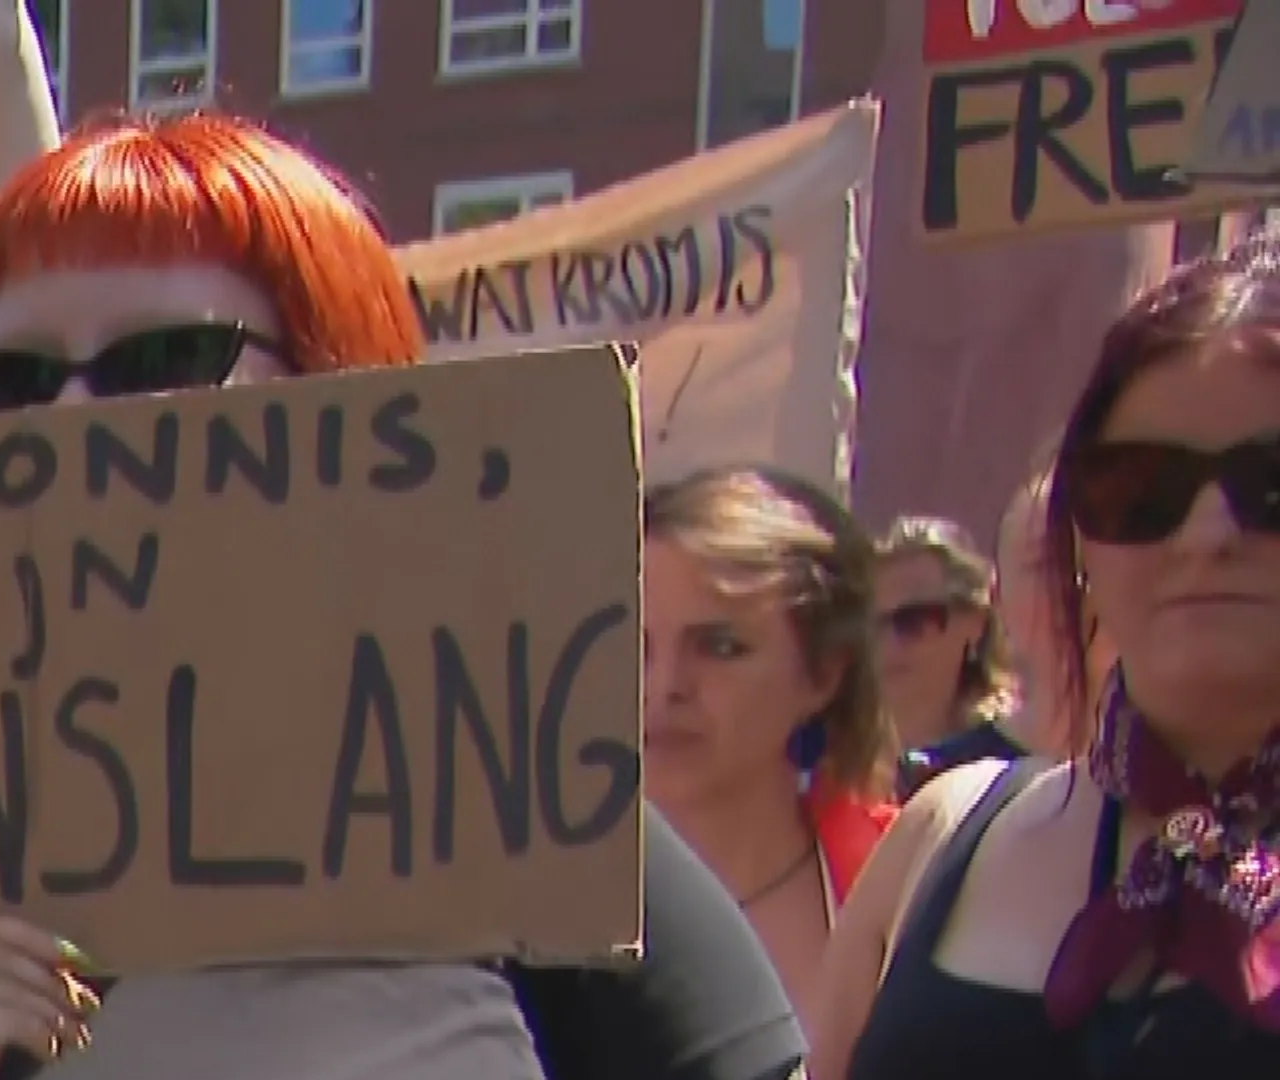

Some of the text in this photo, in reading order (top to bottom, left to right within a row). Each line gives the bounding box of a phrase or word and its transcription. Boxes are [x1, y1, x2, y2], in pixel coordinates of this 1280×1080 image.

[407, 204, 777, 345] WAT KROM IS
